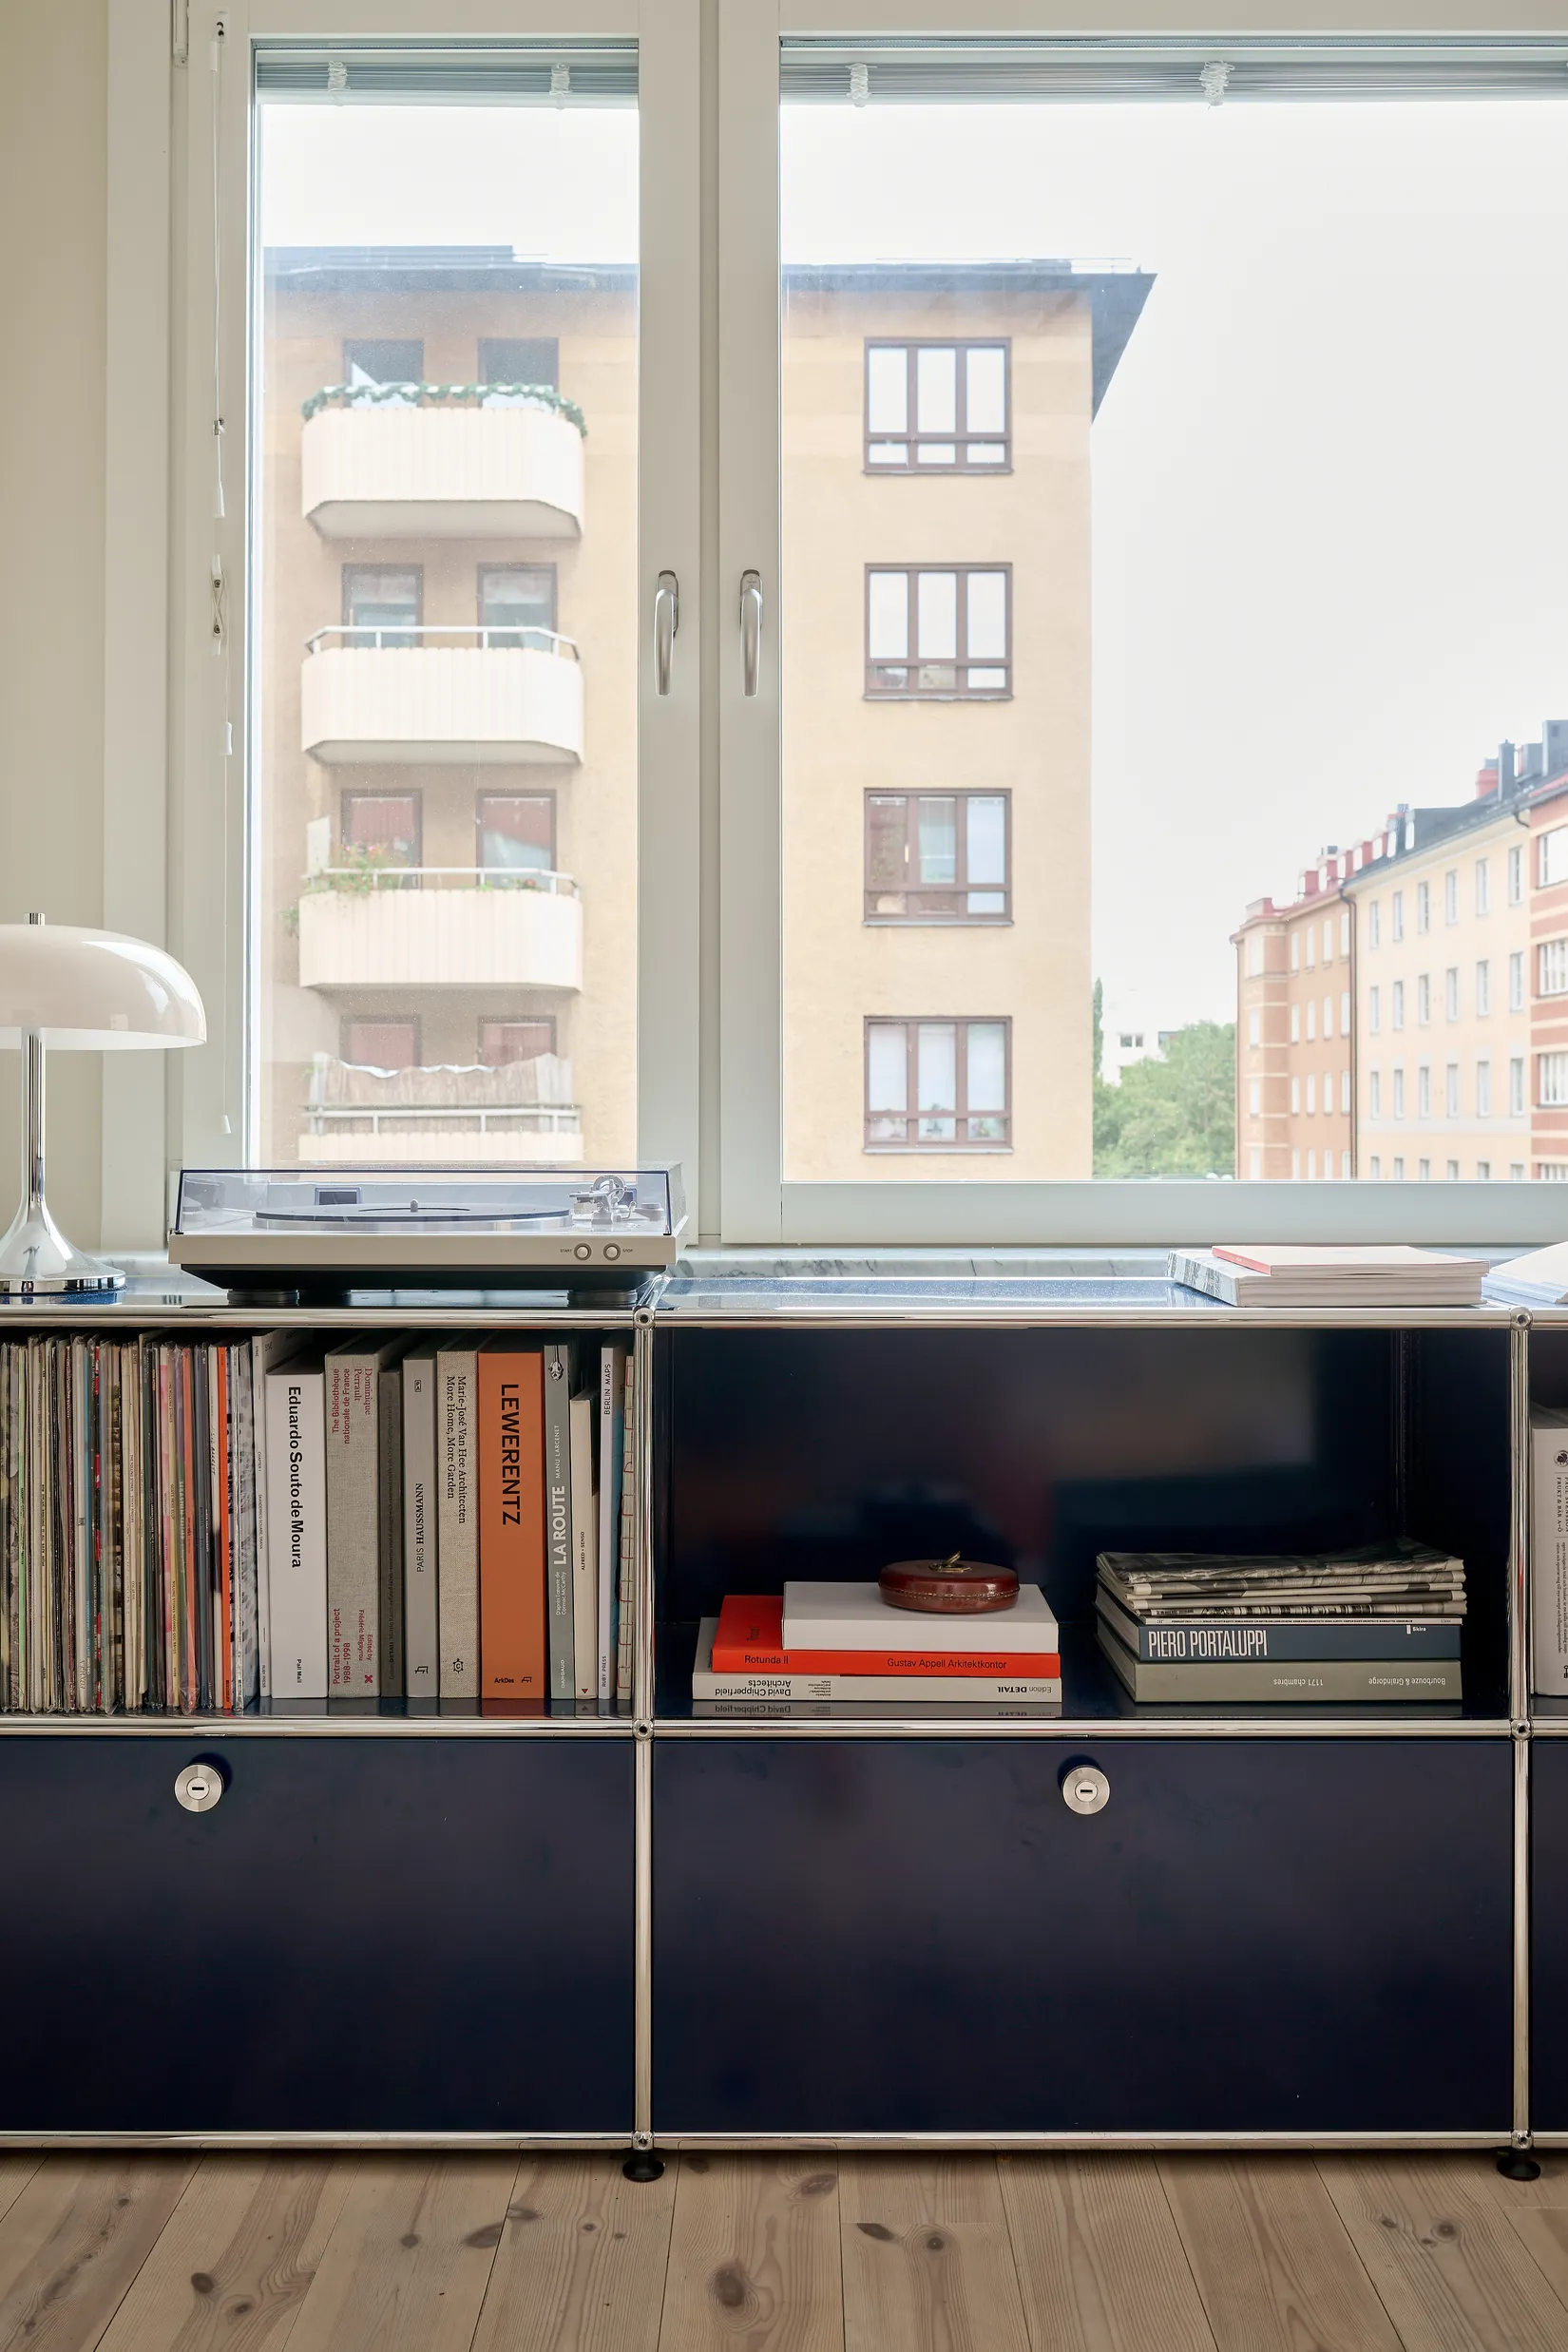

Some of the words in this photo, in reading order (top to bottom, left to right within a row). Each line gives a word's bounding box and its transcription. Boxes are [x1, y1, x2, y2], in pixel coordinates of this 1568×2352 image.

[332, 1368, 340, 1417] Bibliothèque
[342, 1368, 351, 1395] France
[354, 1368, 362, 1402] Perrault
[363, 1367, 373, 1416] Dominique
[447, 1375, 456, 1402] More
[343, 1397, 351, 1406] de
[455, 1375, 467, 1426] Marie-José
[288, 1386, 302, 1449] Eduardo
[342, 1408, 351, 1444] nationale
[446, 1404, 455, 1435] Home,
[447, 1437, 456, 1463] More
[458, 1427, 467, 1446] Van
[458, 1448, 468, 1467] Hee
[501, 1384, 520, 1525] LEWERENTZ
[289, 1451, 303, 1498] Souto
[448, 1463, 456, 1499] Garden
[291, 1499, 304, 1518] de
[458, 1470, 468, 1524] Architecten
[415, 1482, 424, 1544] HAUSSMANN
[551, 1485, 566, 1540] ROUTE
[291, 1520, 304, 1568] Moura
[553, 1543, 567, 1565] LA
[333, 1608, 341, 1636] project
[1148, 1631, 1186, 1657] PIERO
[1190, 1630, 1268, 1657] PORTALUPPI
[744, 1655, 780, 1665] Rotunda
[782, 1655, 789, 1665] II
[887, 1658, 916, 1667] Gustav
[918, 1658, 946, 1670] Appell
[947, 1658, 1007, 1669] Arkitektkontor
[715, 1687, 766, 1696] Chipperfield
[748, 1679, 792, 1688] Architects
[1273, 1678, 1306, 1687] chambres
[1368, 1676, 1405, 1686] Graindorge
[1411, 1677, 1446, 1686] Bourbouze
